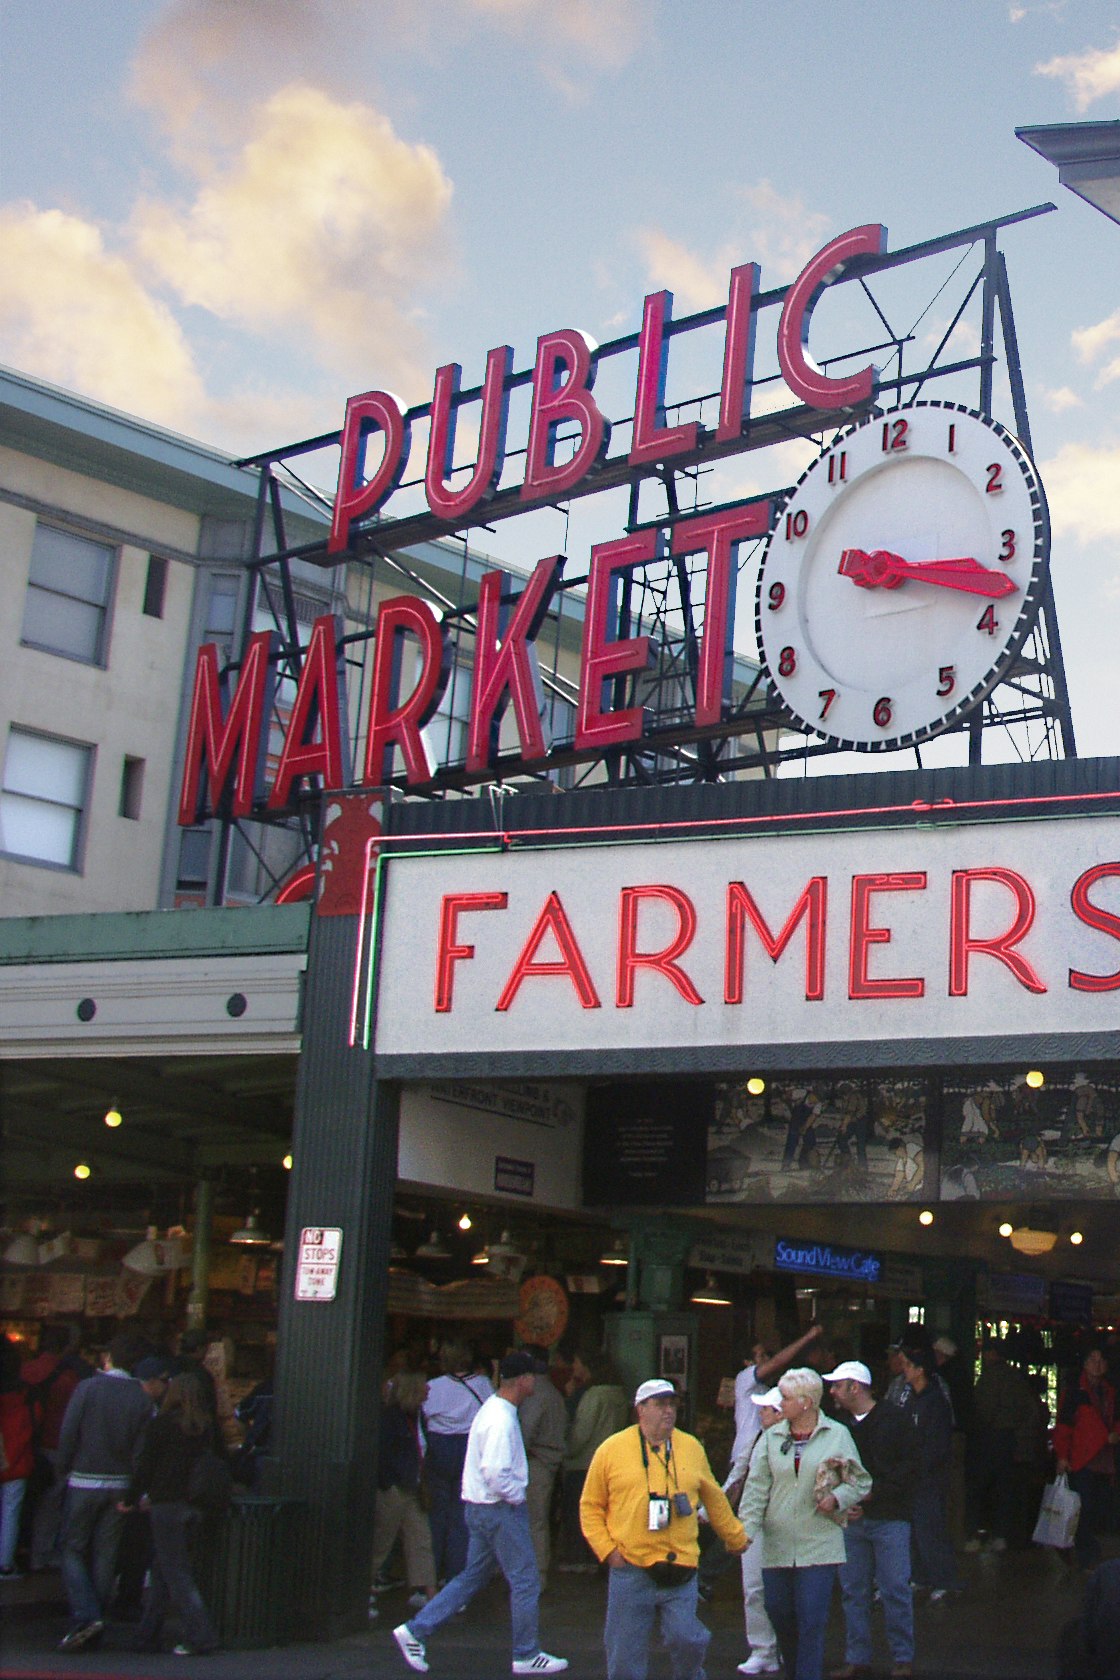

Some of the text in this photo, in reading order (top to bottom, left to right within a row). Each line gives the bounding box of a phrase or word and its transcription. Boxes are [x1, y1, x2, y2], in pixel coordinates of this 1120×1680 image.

[328, 223, 888, 554] PUBLIC
[881, 419, 908, 452] 12
[947, 423, 957, 453] 1
[827, 451, 847, 484] 11
[985, 463, 1003, 493] 2
[785, 509, 808, 541] 10
[998, 529, 1016, 561] 3
[768, 581, 785, 611] 9
[977, 604, 999, 636] 4
[177, 498, 781, 827] MARKET
[779, 646, 796, 677] 8
[936, 666, 957, 697] 5
[818, 688, 837, 719] 7
[873, 697, 892, 727] 6
[304, 1229, 322, 1244] NO
[304, 1248, 335, 1261] STOPS
[776, 1240, 817, 1265] Sound
